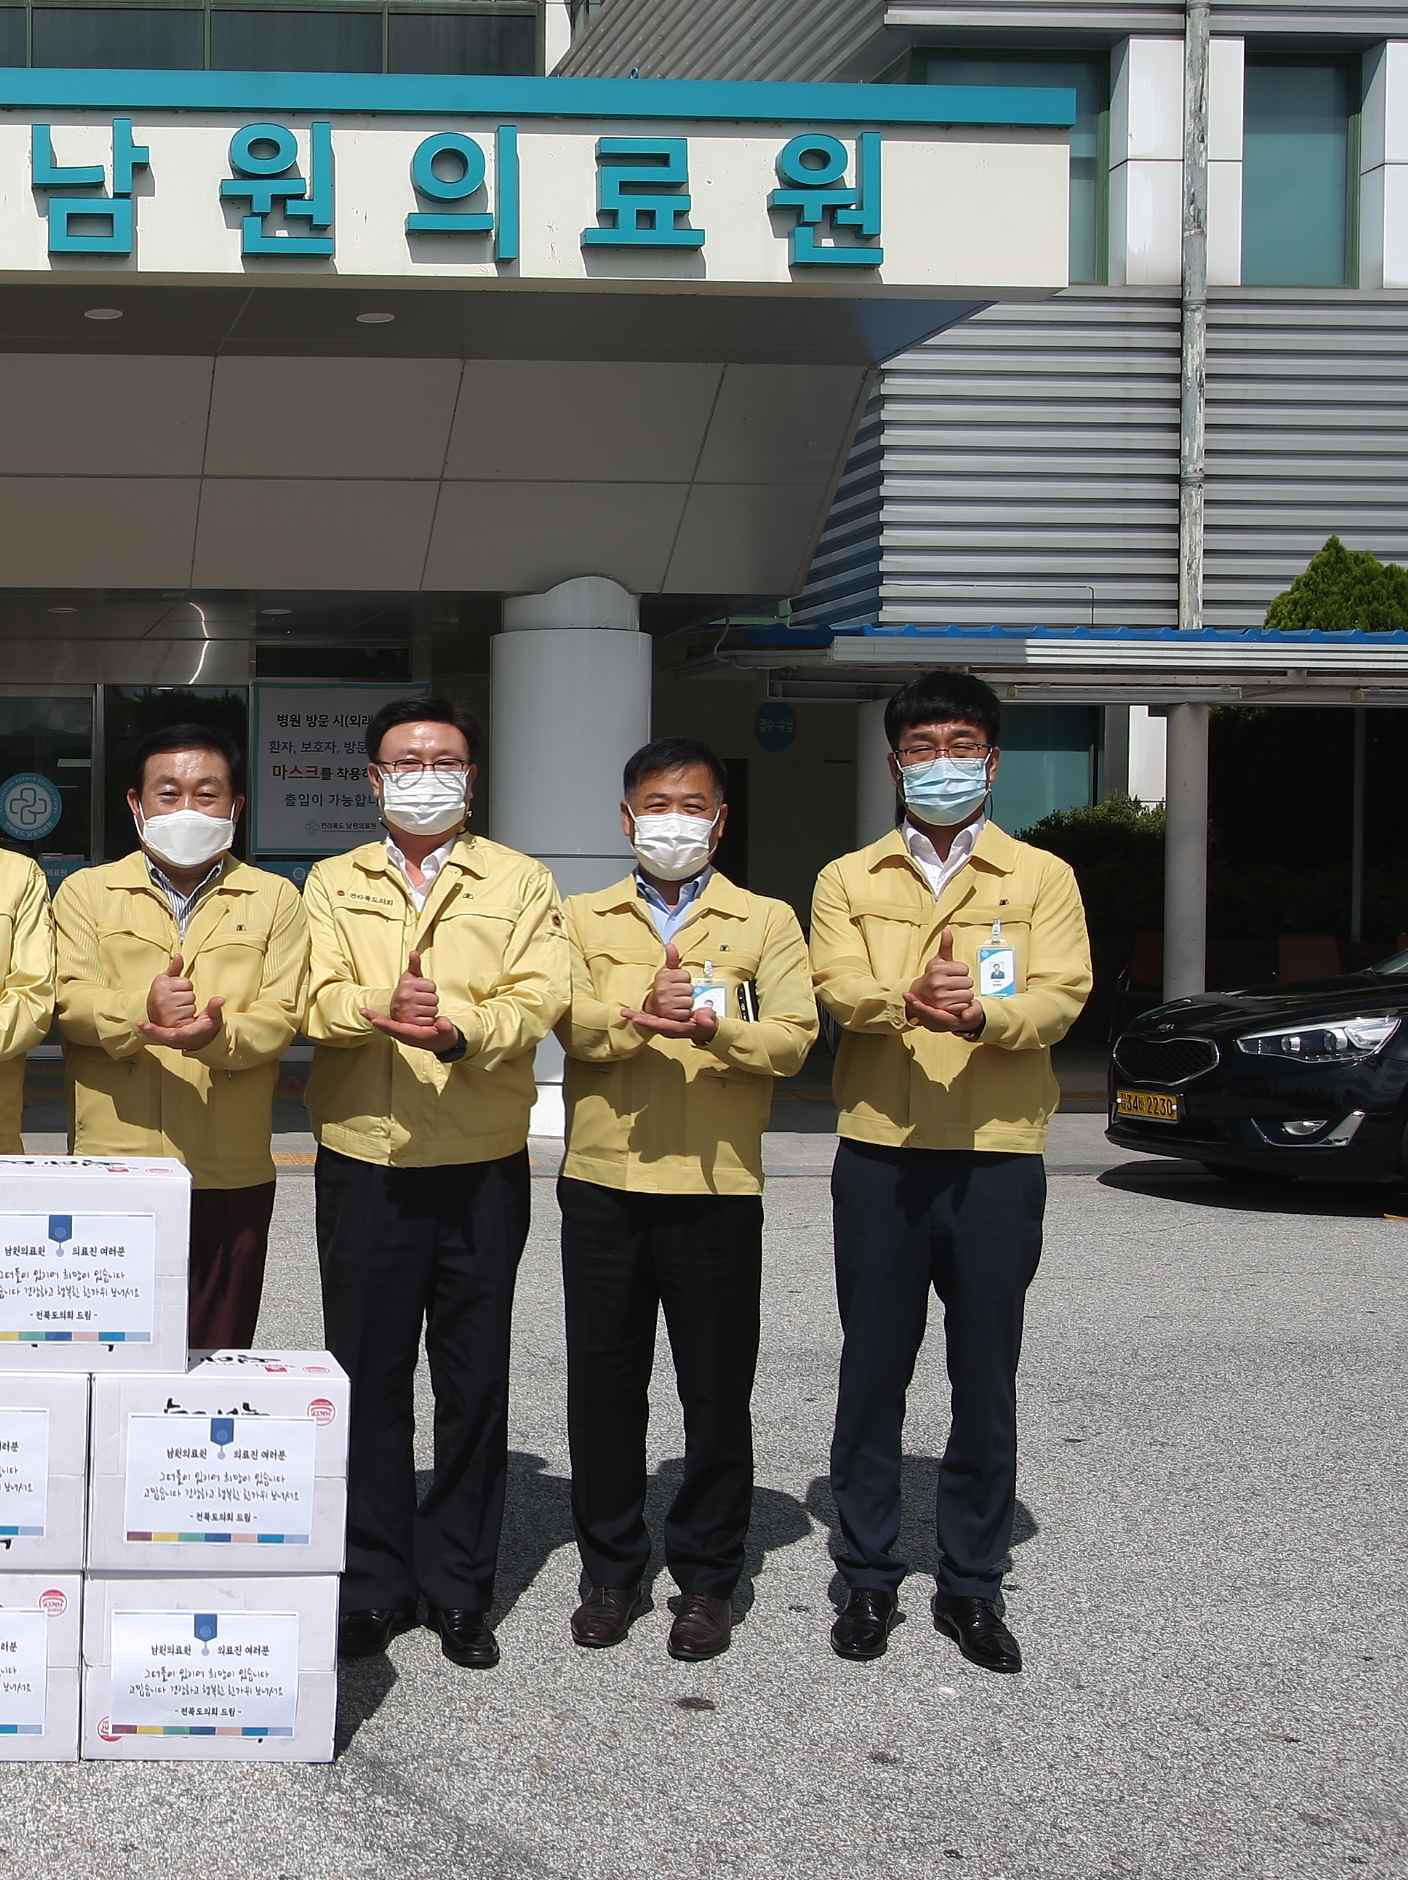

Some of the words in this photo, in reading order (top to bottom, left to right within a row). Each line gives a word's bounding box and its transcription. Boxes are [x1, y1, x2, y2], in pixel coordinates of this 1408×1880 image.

[277, 714, 301, 727] 병원
[306, 714, 330, 727] 방문
[268, 741, 297, 754] 환자,
[300, 741, 340, 754] 보호자,
[272, 765, 333, 781] 마스크를
[284, 794, 323, 807] 출입이
[321, 822, 344, 830] 전라북도
[345, 822, 376, 830] 남원의료원
[1147, 1096, 1173, 1115] 2230
[5, 1245, 45, 1257] 남원의료원
[72, 1246, 97, 1257] 의료진
[100, 1246, 125, 1257] 여러분
[34, 1269, 59, 1283] 있기에
[63, 1269, 89, 1281] 희망이
[94, 1268, 125, 1283] 있습니다
[36, 1310, 73, 1320] 전북도의회
[76, 1310, 91, 1320] 드림
[167, 1447, 207, 1460] 남원의료원
[234, 1449, 258, 1460] 의료진
[261, 1449, 286, 1461] 여러분
[196, 1511, 233, 1522] 전북도의회
[236, 1512, 251, 1523] 드림
[151, 1644, 191, 1655] 남원의료원
[217, 1644, 242, 1655] 의료진
[245, 1645, 270, 1655] 여러분
[181, 1706, 218, 1716] 전북도의회
[220, 1707, 235, 1717] 드림
